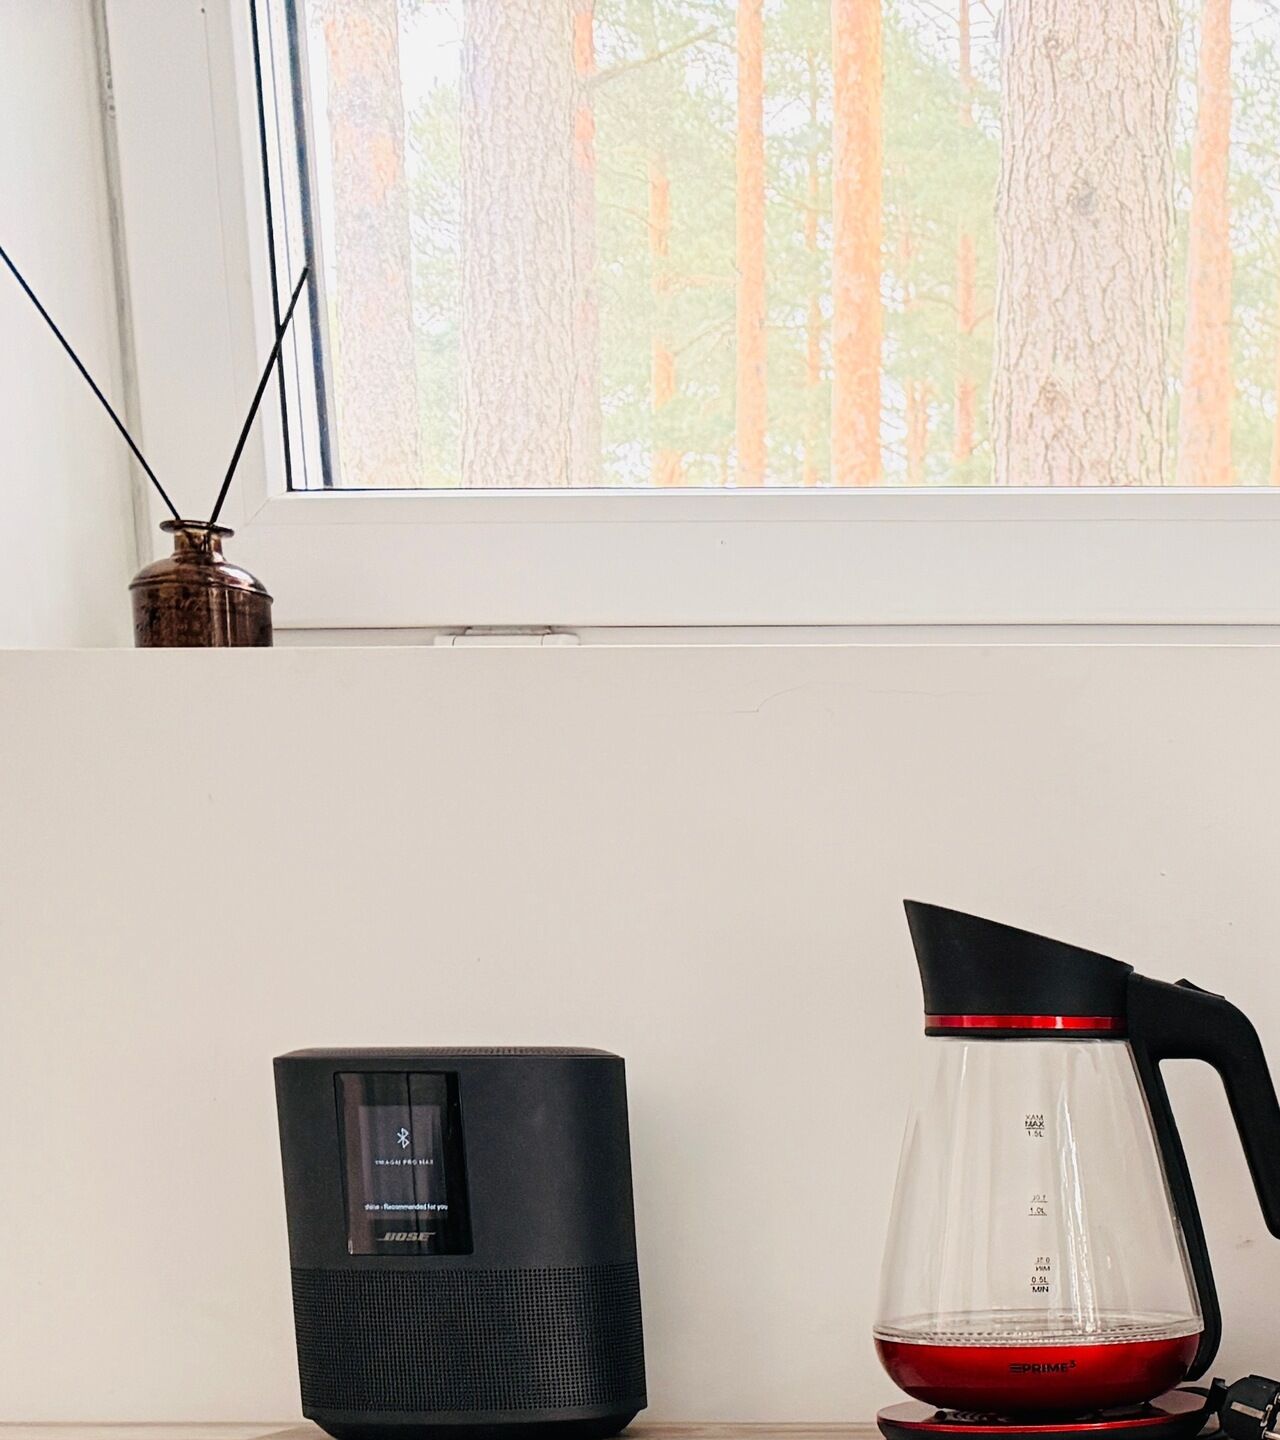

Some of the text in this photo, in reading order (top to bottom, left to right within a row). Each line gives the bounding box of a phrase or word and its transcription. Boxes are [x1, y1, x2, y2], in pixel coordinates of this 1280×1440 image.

[1024, 1120, 1045, 1128] MAX
[437, 1204, 448, 1212] you
[377, 1231, 437, 1242] BOSE
[1031, 1285, 1050, 1293] MIN
